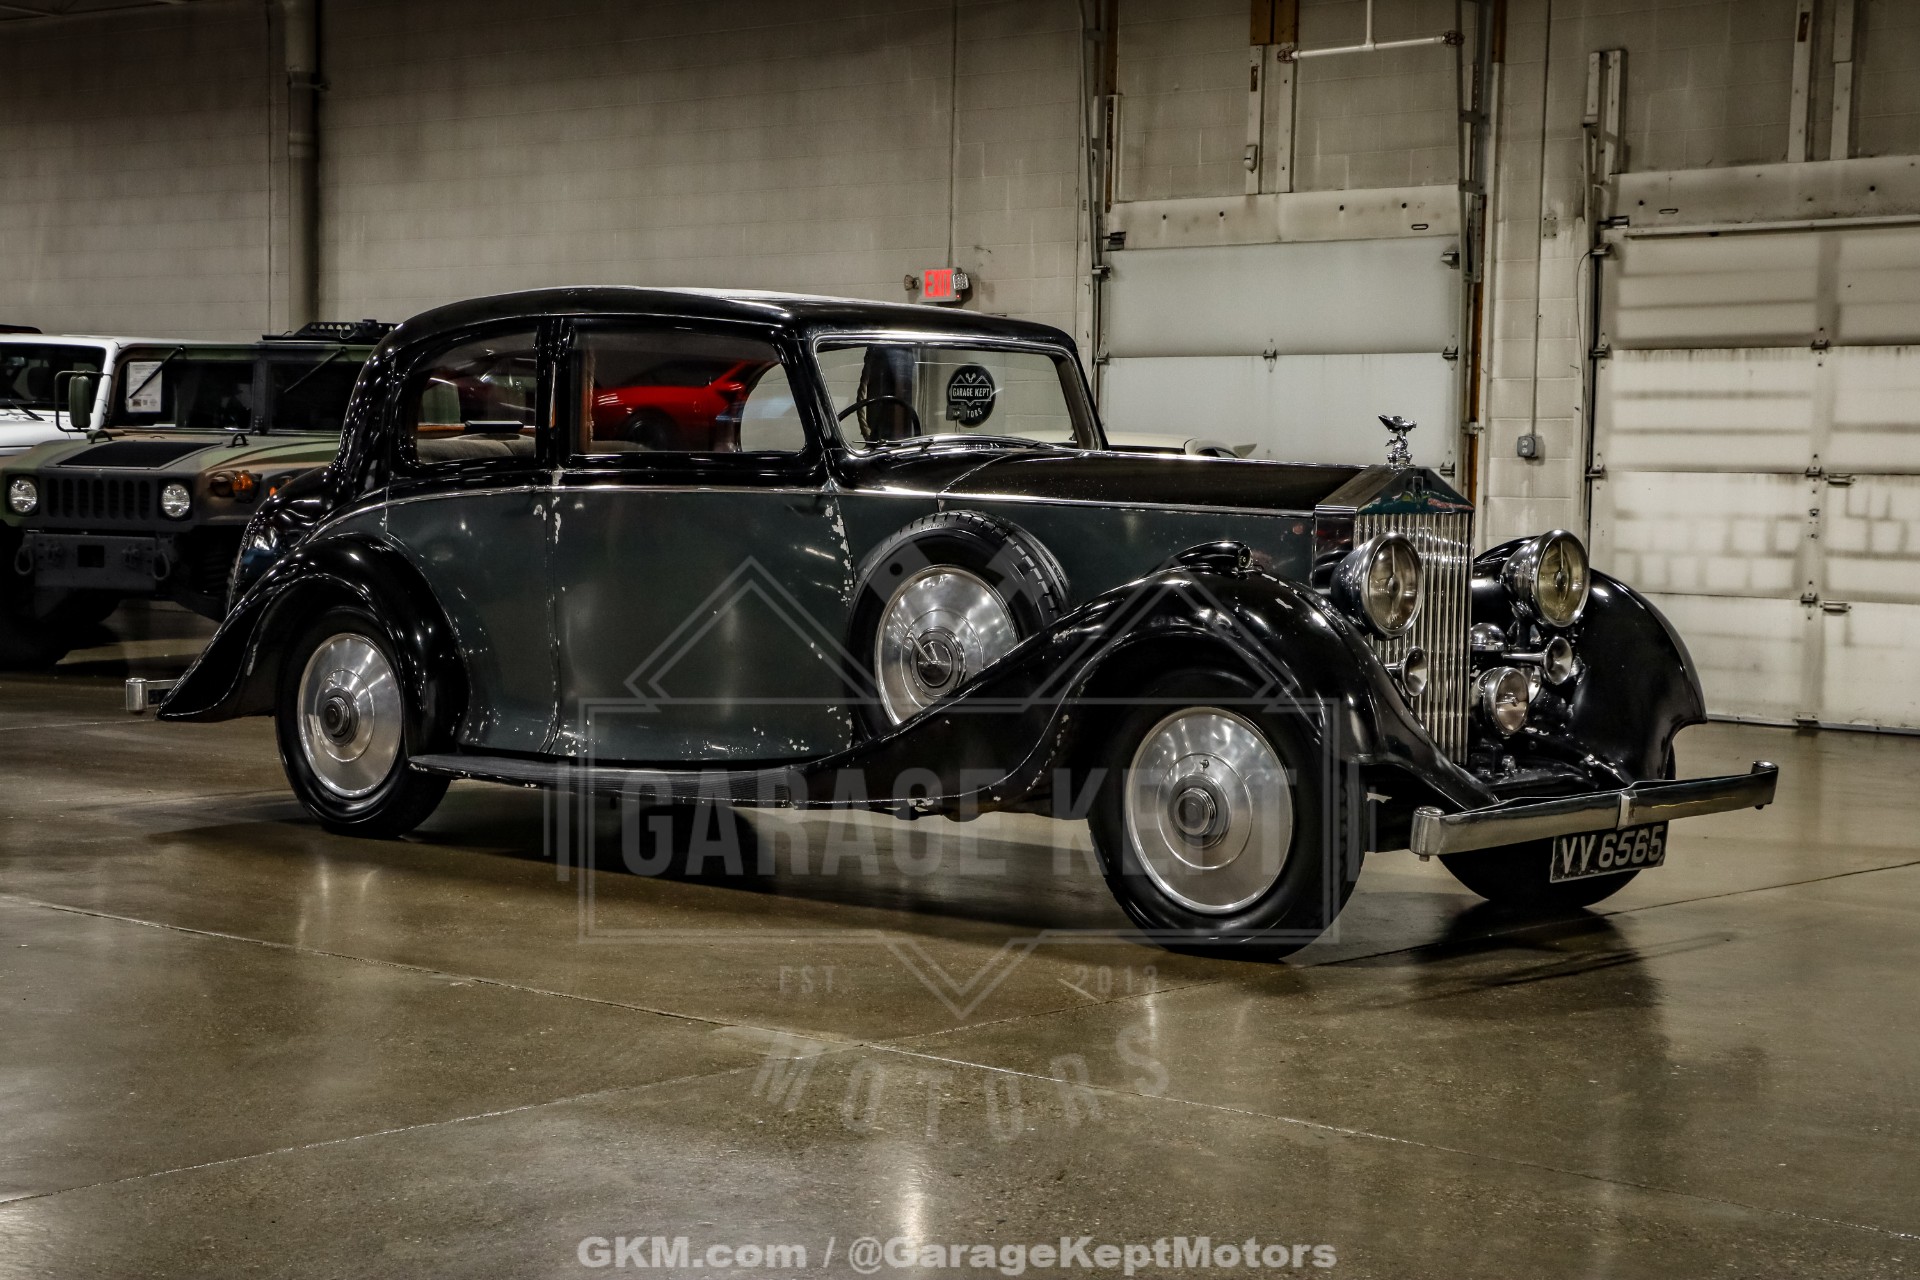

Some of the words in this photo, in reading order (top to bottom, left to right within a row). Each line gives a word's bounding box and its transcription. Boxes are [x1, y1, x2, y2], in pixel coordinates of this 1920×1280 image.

[925, 270, 952, 297] EXIT
[952, 388, 973, 397] GARAGE
[975, 388, 990, 397] KEPT
[1598, 825, 1665, 868] 6565
